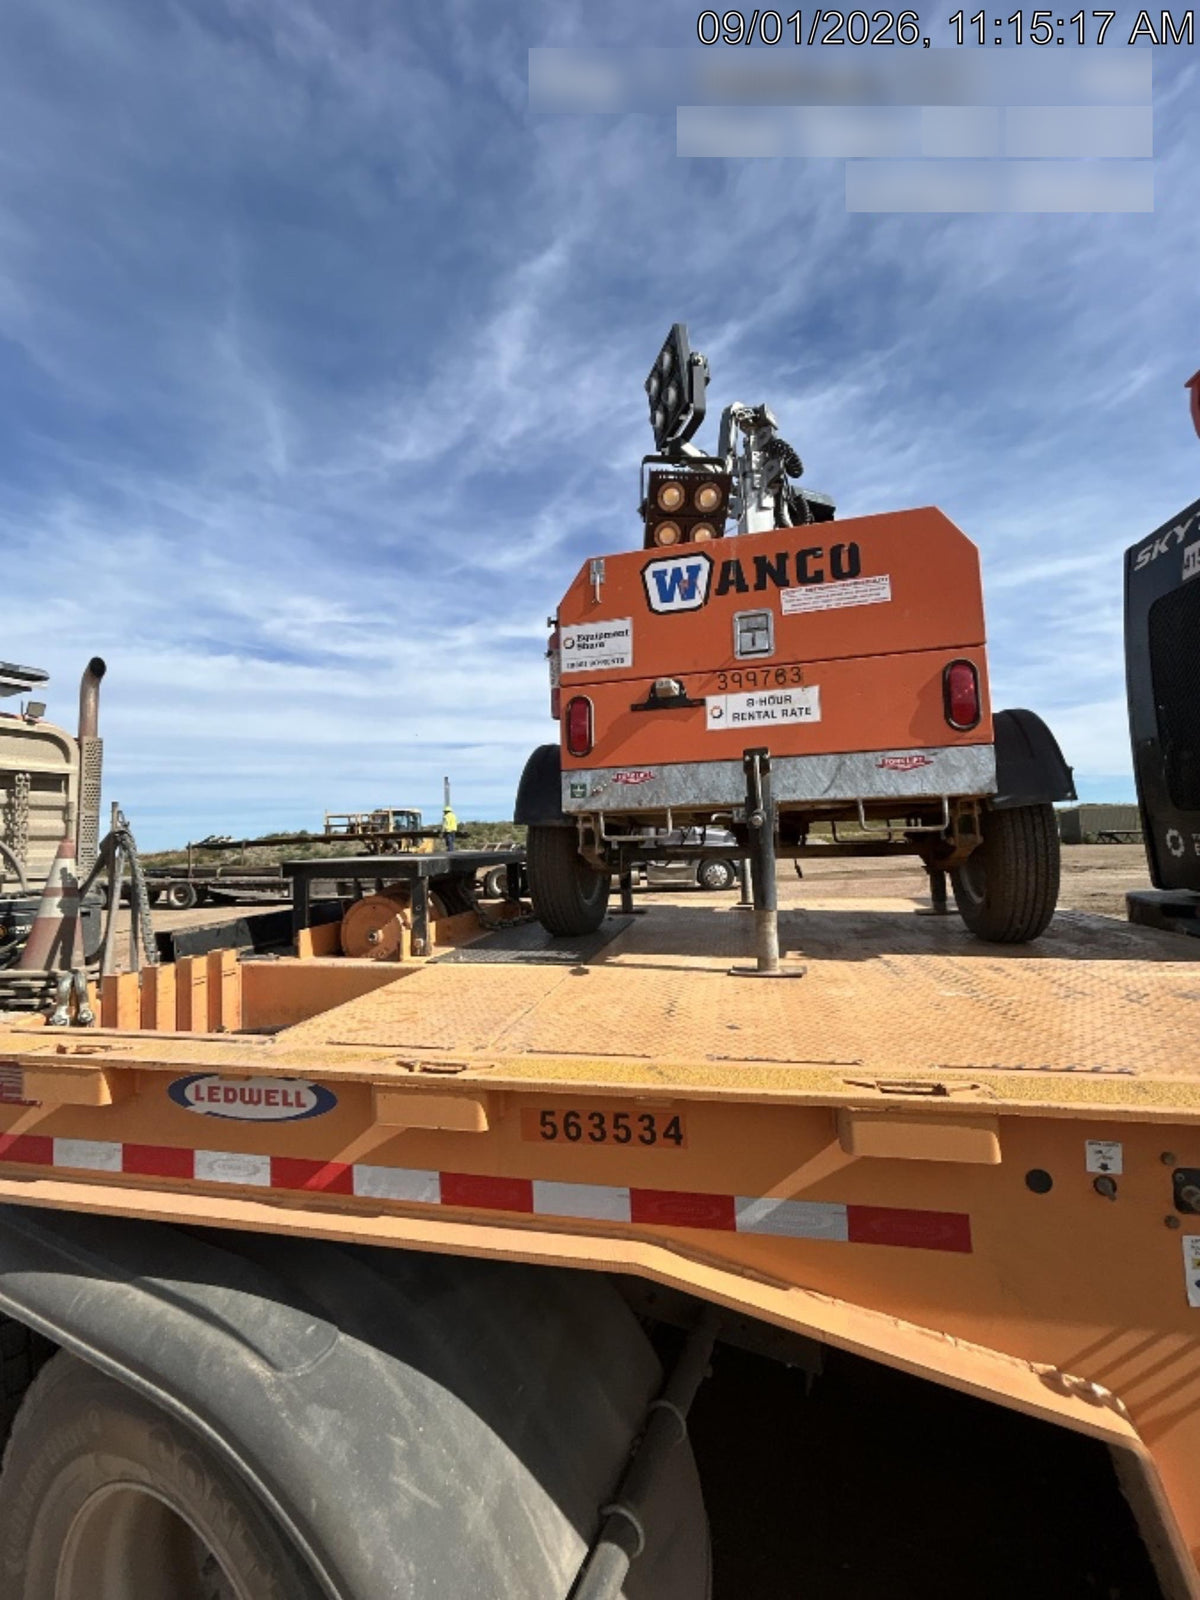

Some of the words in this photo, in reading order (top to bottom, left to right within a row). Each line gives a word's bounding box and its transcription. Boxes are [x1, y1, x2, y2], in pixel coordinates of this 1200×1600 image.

[651, 541, 861, 604] WANCO
[732, 710, 777, 722] RENTAL
[781, 706, 812, 718] RATE
[193, 1083, 308, 1109] LEDWELL
[539, 1110, 684, 1146] 563534
